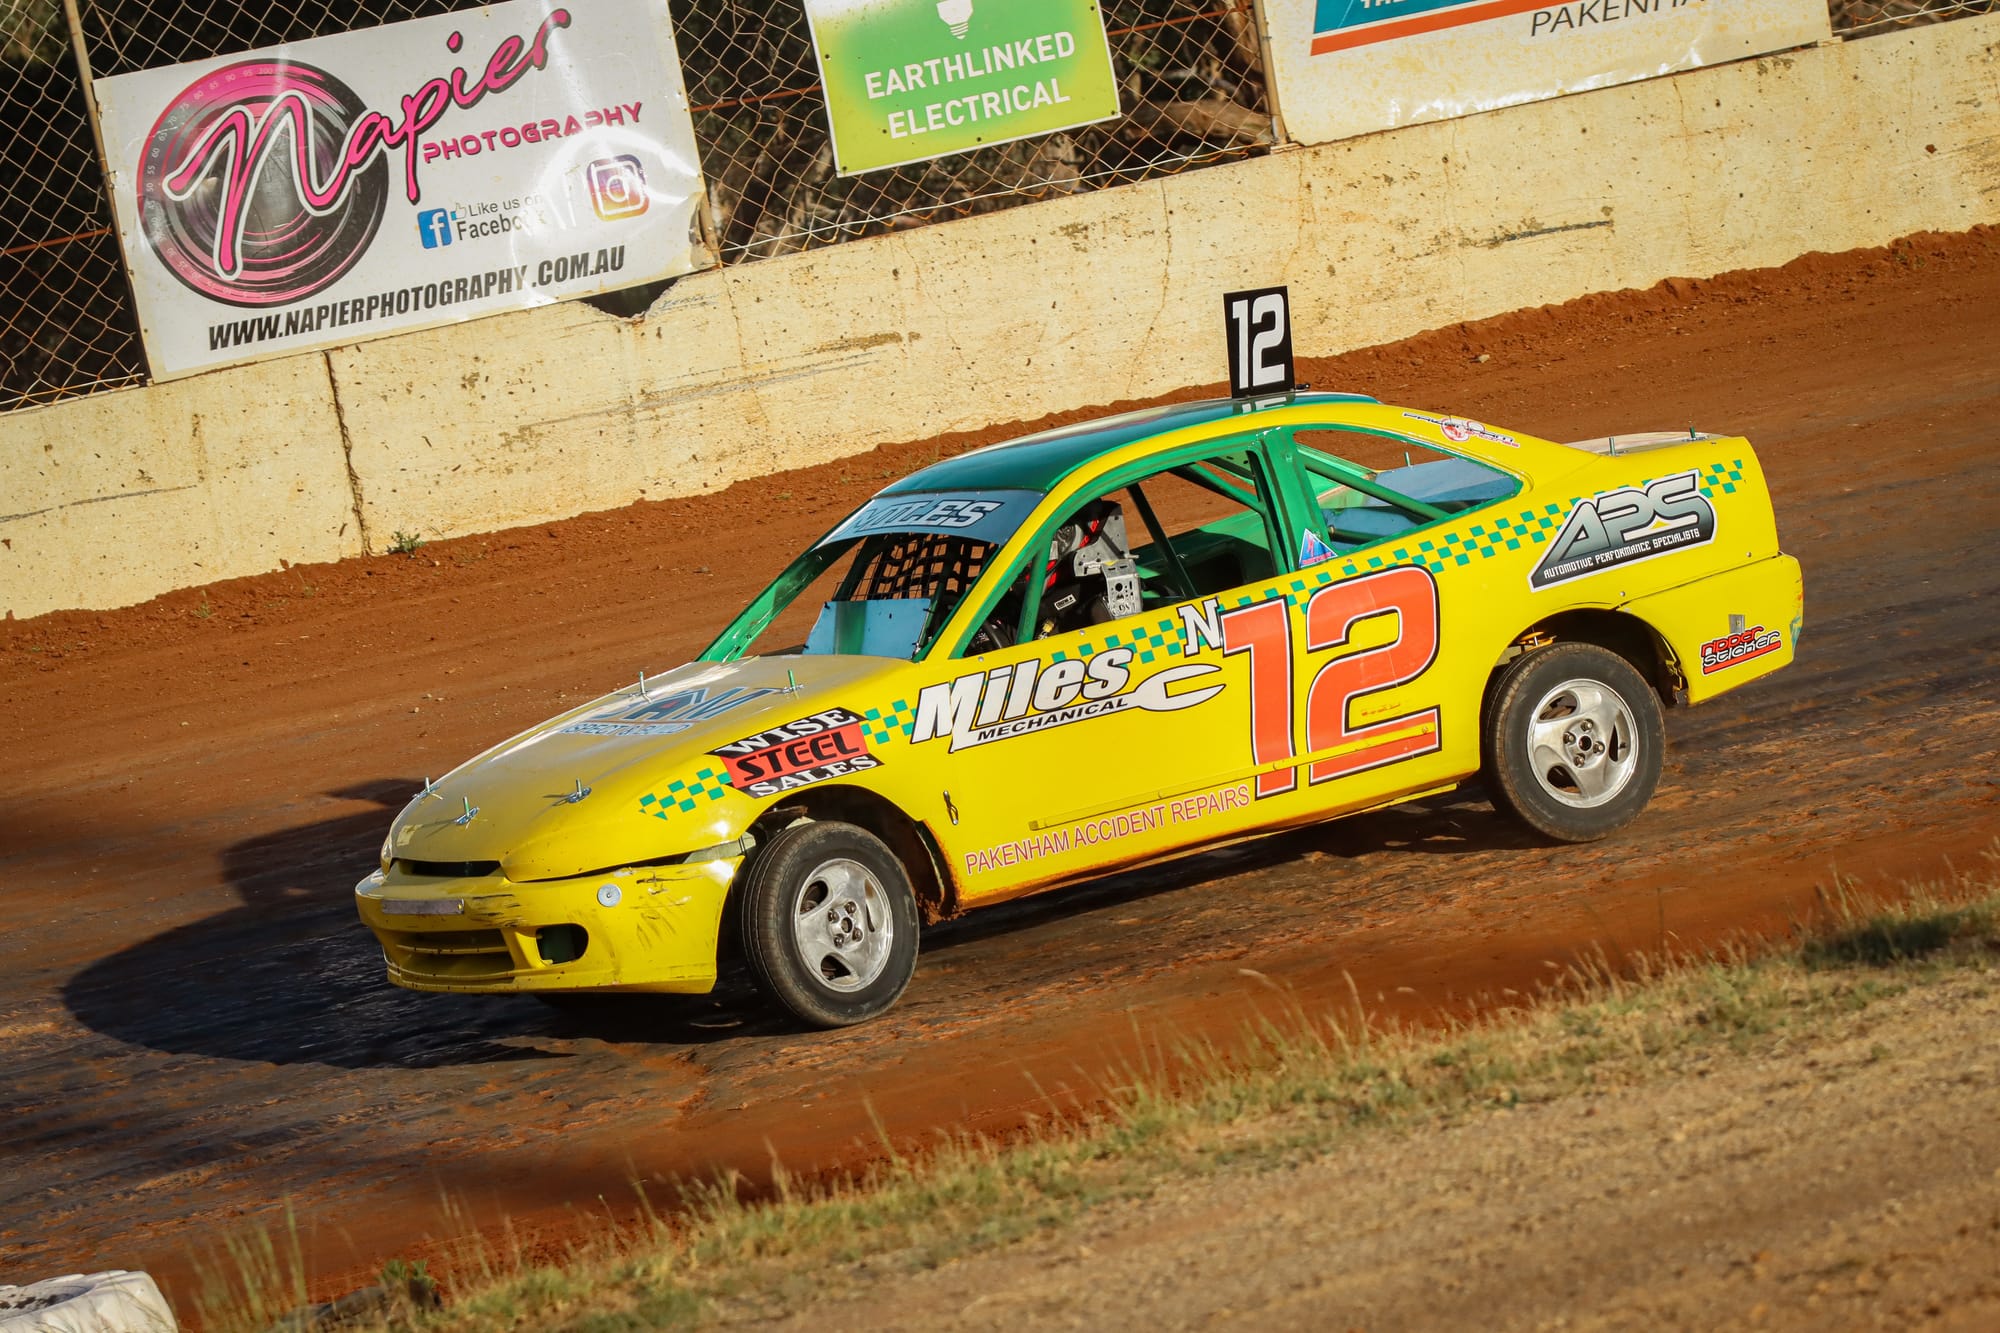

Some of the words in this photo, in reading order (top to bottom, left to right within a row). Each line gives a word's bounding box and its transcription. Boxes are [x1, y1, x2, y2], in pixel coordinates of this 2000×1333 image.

[865, 31, 1075, 99] EARTHLINKED
[422, 101, 643, 164] PHOTOGRAPHY
[888, 78, 1071, 139] ELECTRICAL
[166, 8, 572, 280] Napier
[468, 202, 498, 217] Like
[503, 198, 520, 210] us
[1232, 293, 1285, 390] 12
[855, 499, 1005, 533] MILES
[1546, 473, 1714, 564] APS
[1543, 556, 1593, 579] AUTOMOTIVE
[1594, 540, 1651, 565] PERFORMANCE
[1652, 527, 1700, 549] SPECIALISTS
[1176, 596, 1222, 658] N
[910, 647, 1135, 754] Miles
[1220, 564, 1442, 801] 12
[714, 709, 858, 754] WISE
[977, 698, 1128, 742] MECHANICAL
[736, 731, 860, 782] STEEL
[750, 756, 877, 796] SALES
[965, 830, 1070, 875] PAKENHAM
[1074, 805, 1166, 848] ACCIDENT
[1171, 784, 1250, 824] REPAIRS
